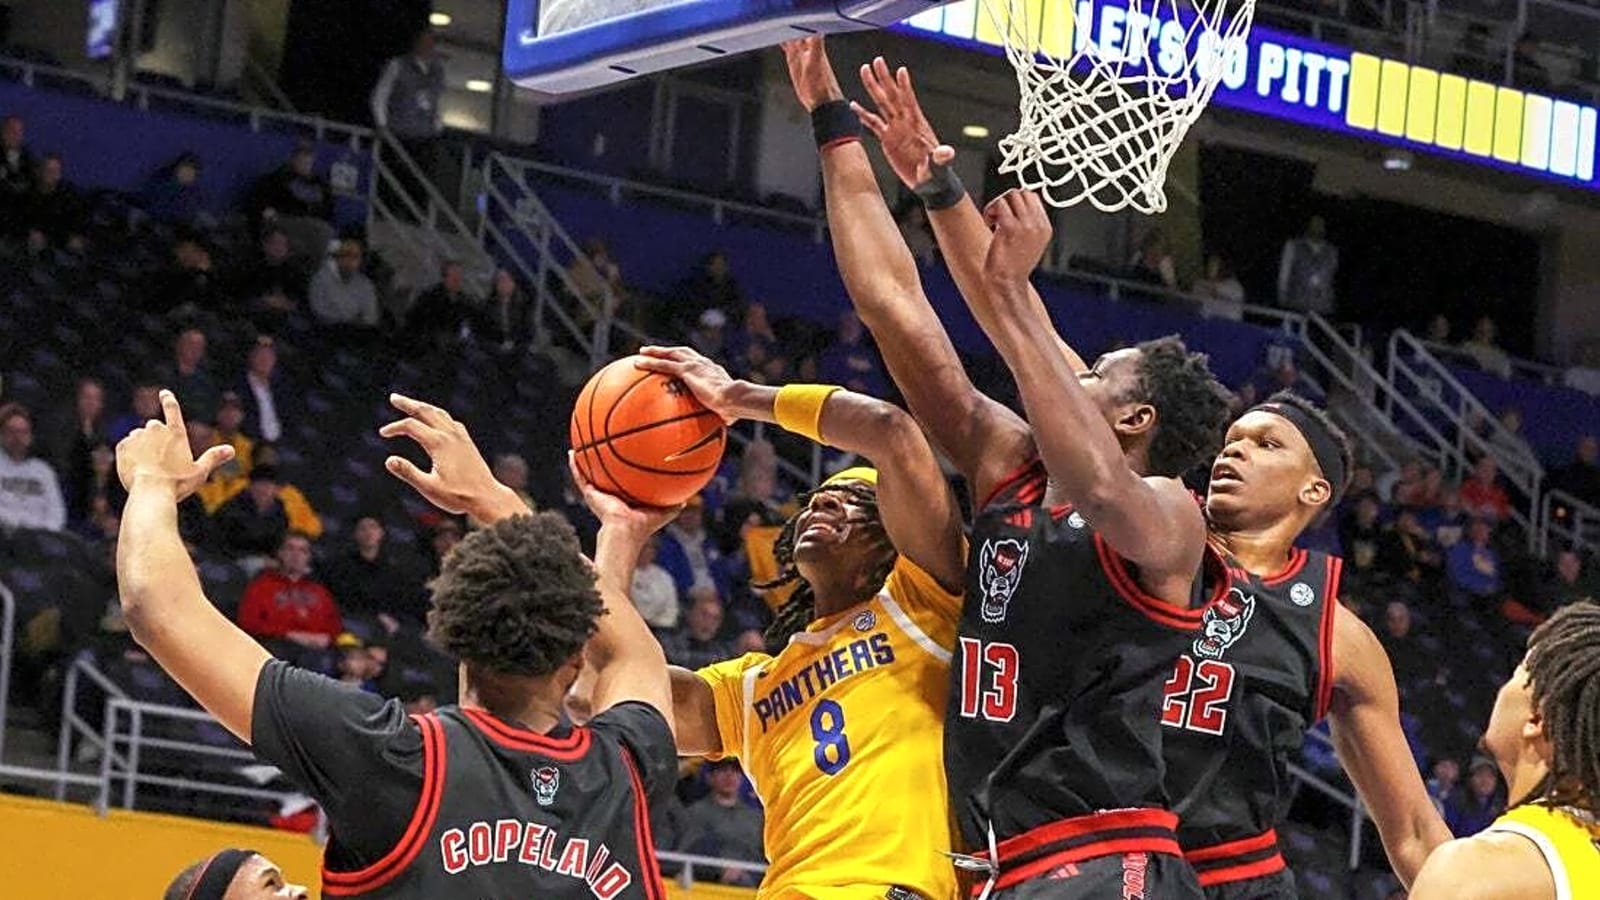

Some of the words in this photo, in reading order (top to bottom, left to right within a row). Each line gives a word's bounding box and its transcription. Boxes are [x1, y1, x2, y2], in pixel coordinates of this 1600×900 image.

[1075, 0, 1186, 75] LET'S
[1257, 42, 1350, 113] PITT
[753, 632, 896, 735] PANTHERS
[959, 636, 1019, 723] 13
[1161, 654, 1235, 736] 22
[810, 698, 851, 776] 8
